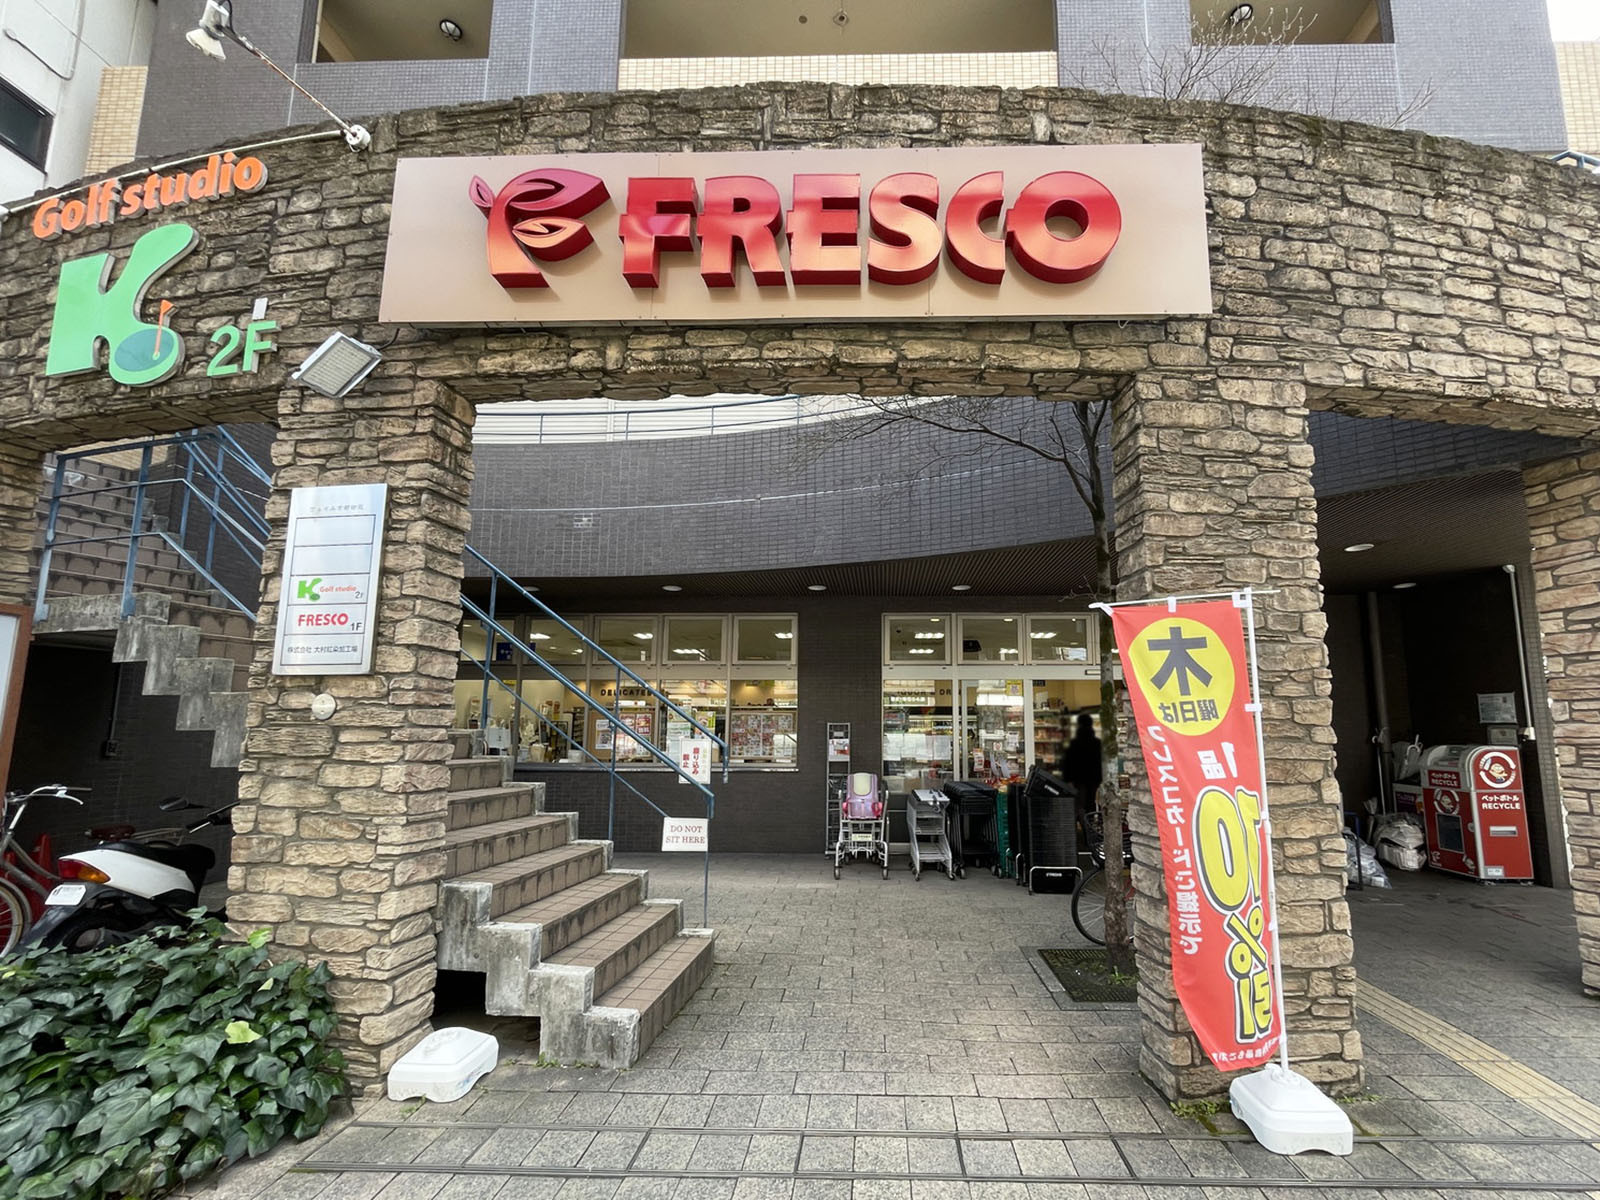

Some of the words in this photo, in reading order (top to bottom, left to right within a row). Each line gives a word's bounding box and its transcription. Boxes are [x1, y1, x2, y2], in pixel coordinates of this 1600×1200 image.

[32, 180, 119, 239] Golf
[120, 152, 269, 218] studio
[619, 170, 1122, 289] FRESCO
[207, 320, 281, 377] 2F
[298, 613, 349, 627] FRESCO
[350, 622, 363, 631] 1F
[1481, 802, 1521, 810] RECYCLE
[670, 825, 683, 833] DO
[684, 825, 702, 833] NOT
[665, 836, 681, 844] SIT
[682, 836, 705, 844] HERE
